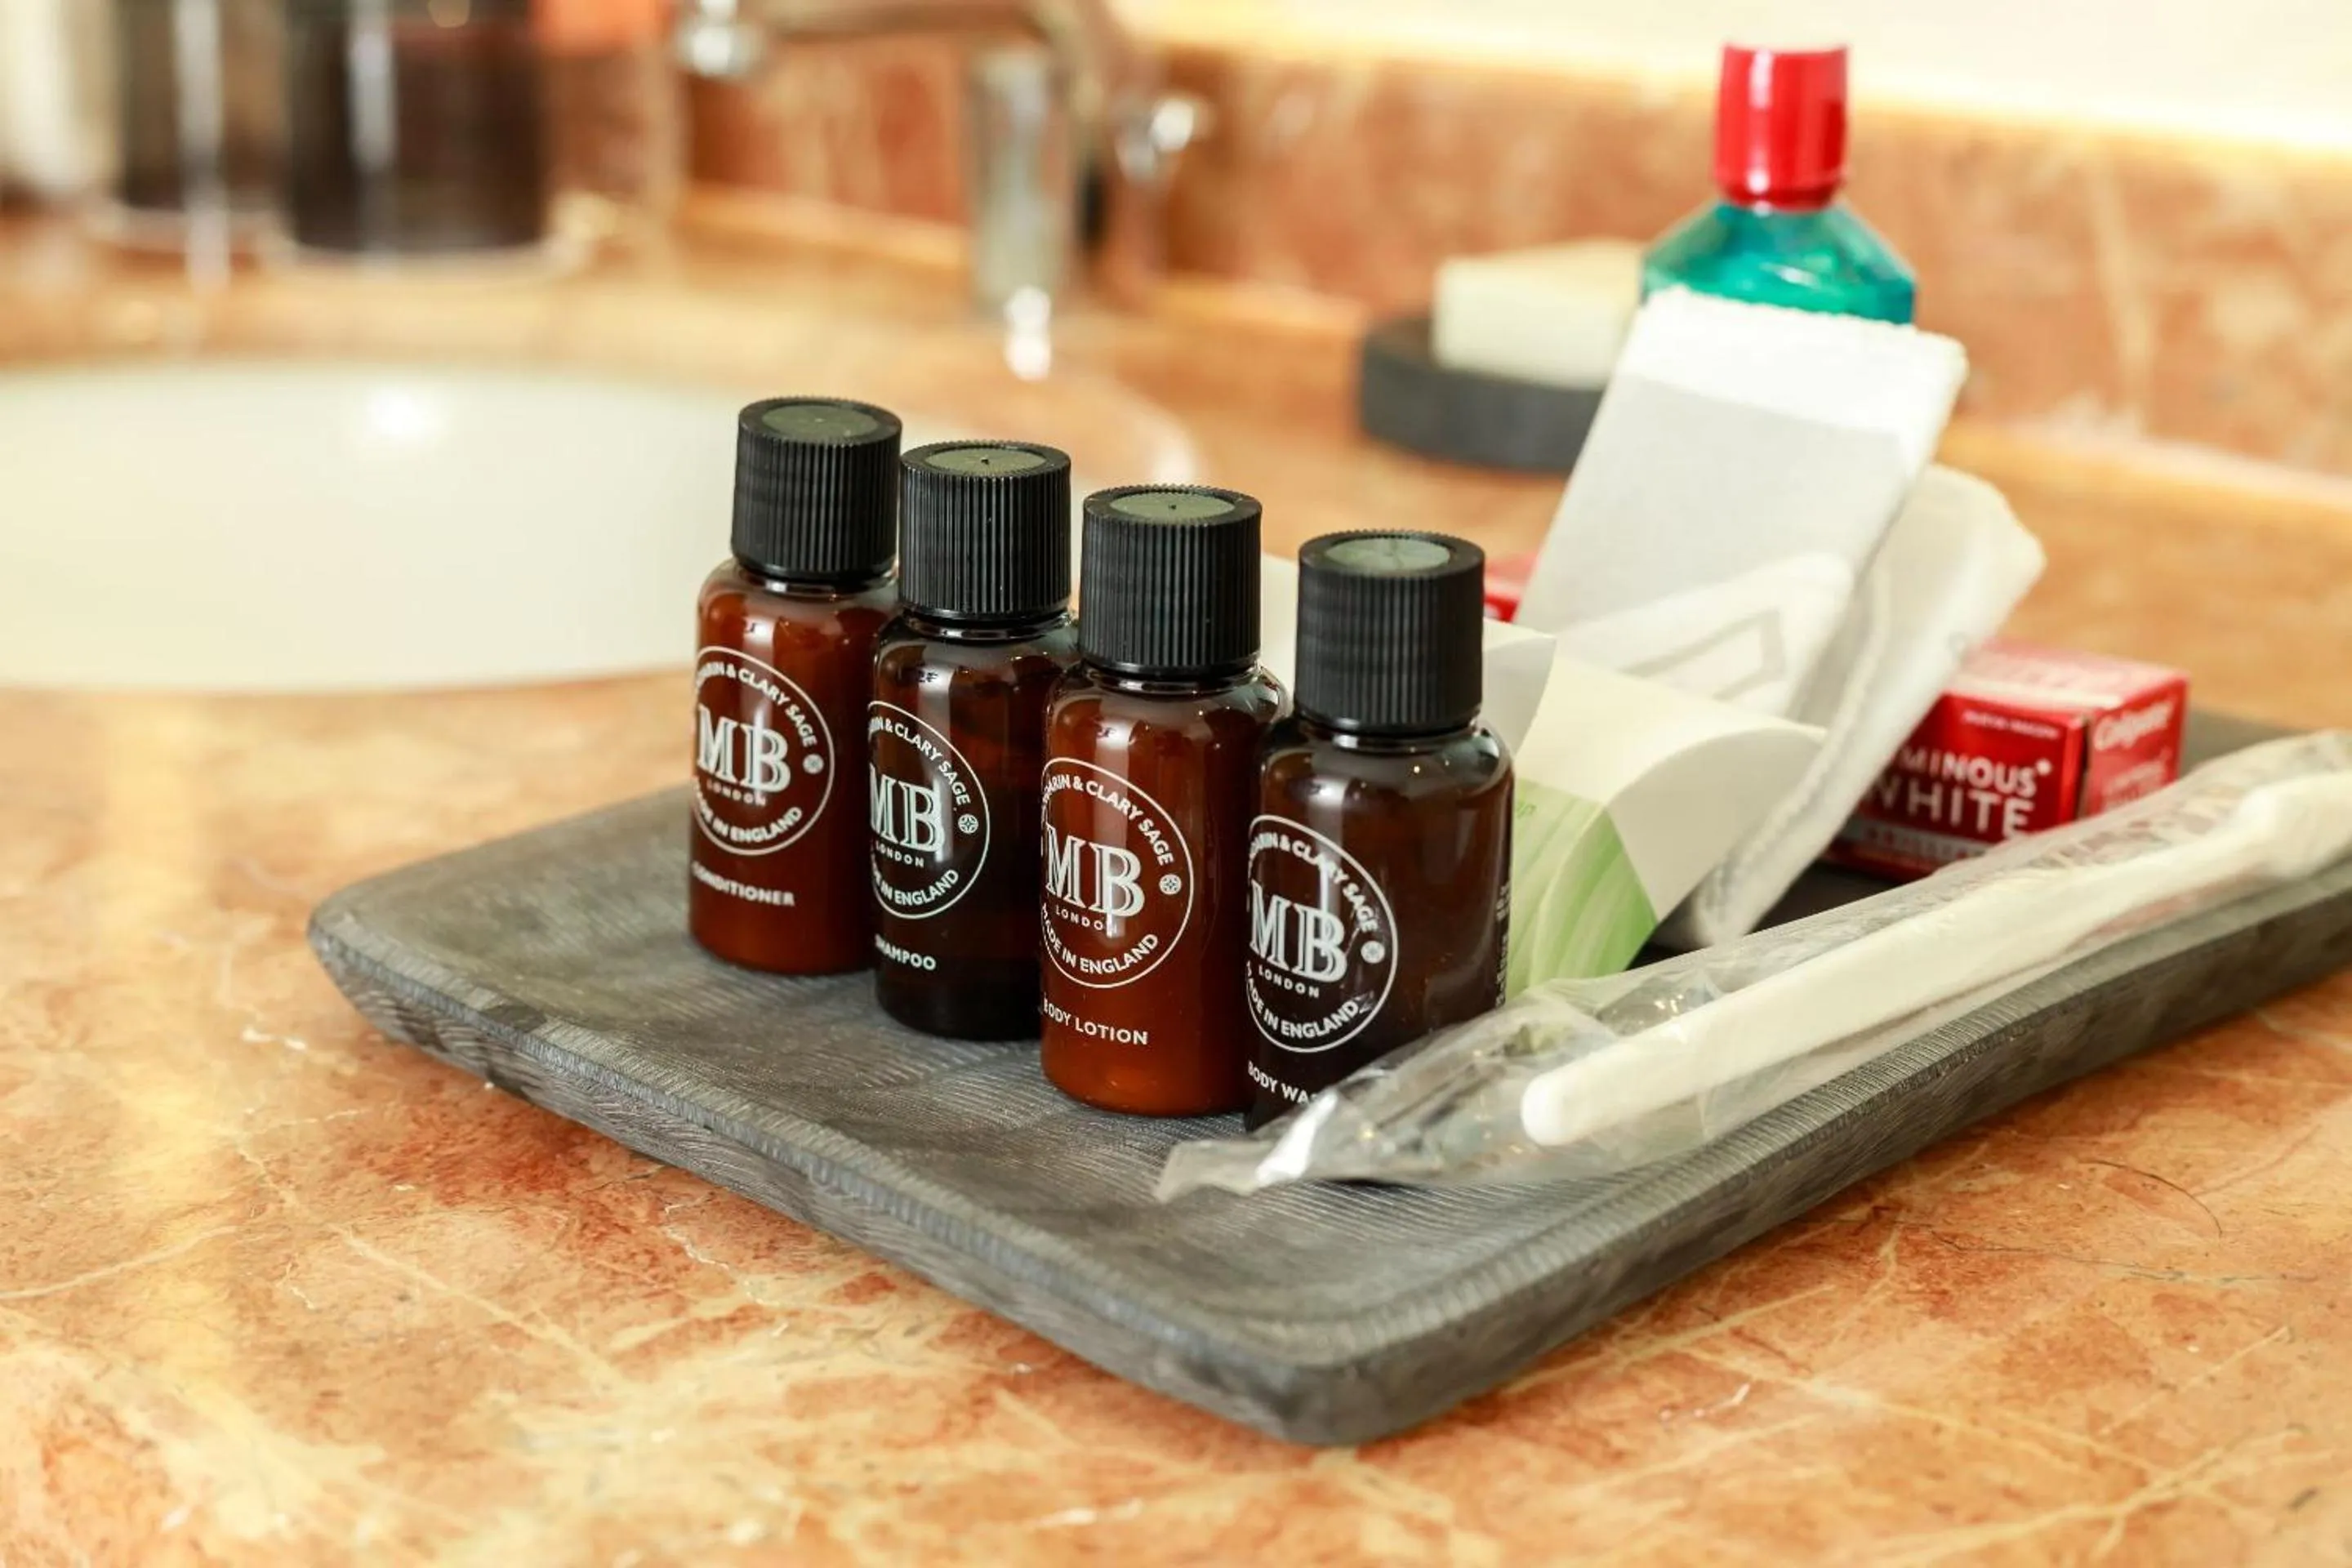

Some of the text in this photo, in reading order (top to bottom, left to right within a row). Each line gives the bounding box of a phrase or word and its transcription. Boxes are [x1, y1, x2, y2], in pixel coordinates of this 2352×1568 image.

[726, 664, 737, 679] &
[738, 670, 791, 706] CLARY
[785, 703, 817, 747] SAGE
[697, 703, 791, 792] MB
[885, 719, 894, 733] &
[895, 724, 942, 761] CLARY
[939, 760, 971, 806] SAGE
[1900, 745, 2038, 799] MINOUS
[706, 780, 767, 806] LONDON
[869, 763, 945, 853] MB
[730, 806, 803, 844] ENGLAND
[1072, 776, 1084, 791] &
[1085, 781, 1143, 821] CLARY
[1138, 818, 1174, 866] SAGE
[876, 840, 925, 868] LONDON
[1046, 822, 1145, 918] MB
[894, 869, 959, 906] ENGLAND
[1280, 835, 1290, 853] &
[1291, 840, 1348, 884] CLARY
[1343, 883, 1379, 933] SAGE
[1062, 947, 1076, 968] IN
[1080, 933, 1159, 974] ENGLAND
[1250, 879, 1348, 982] MB
[1258, 964, 1320, 999] LONDON
[1075, 1017, 1148, 1045] LOTION
[1263, 1008, 1279, 1029] IN
[1281, 1000, 1359, 1039] ENGLAND
[1248, 1060, 1318, 1104] BODY WA
